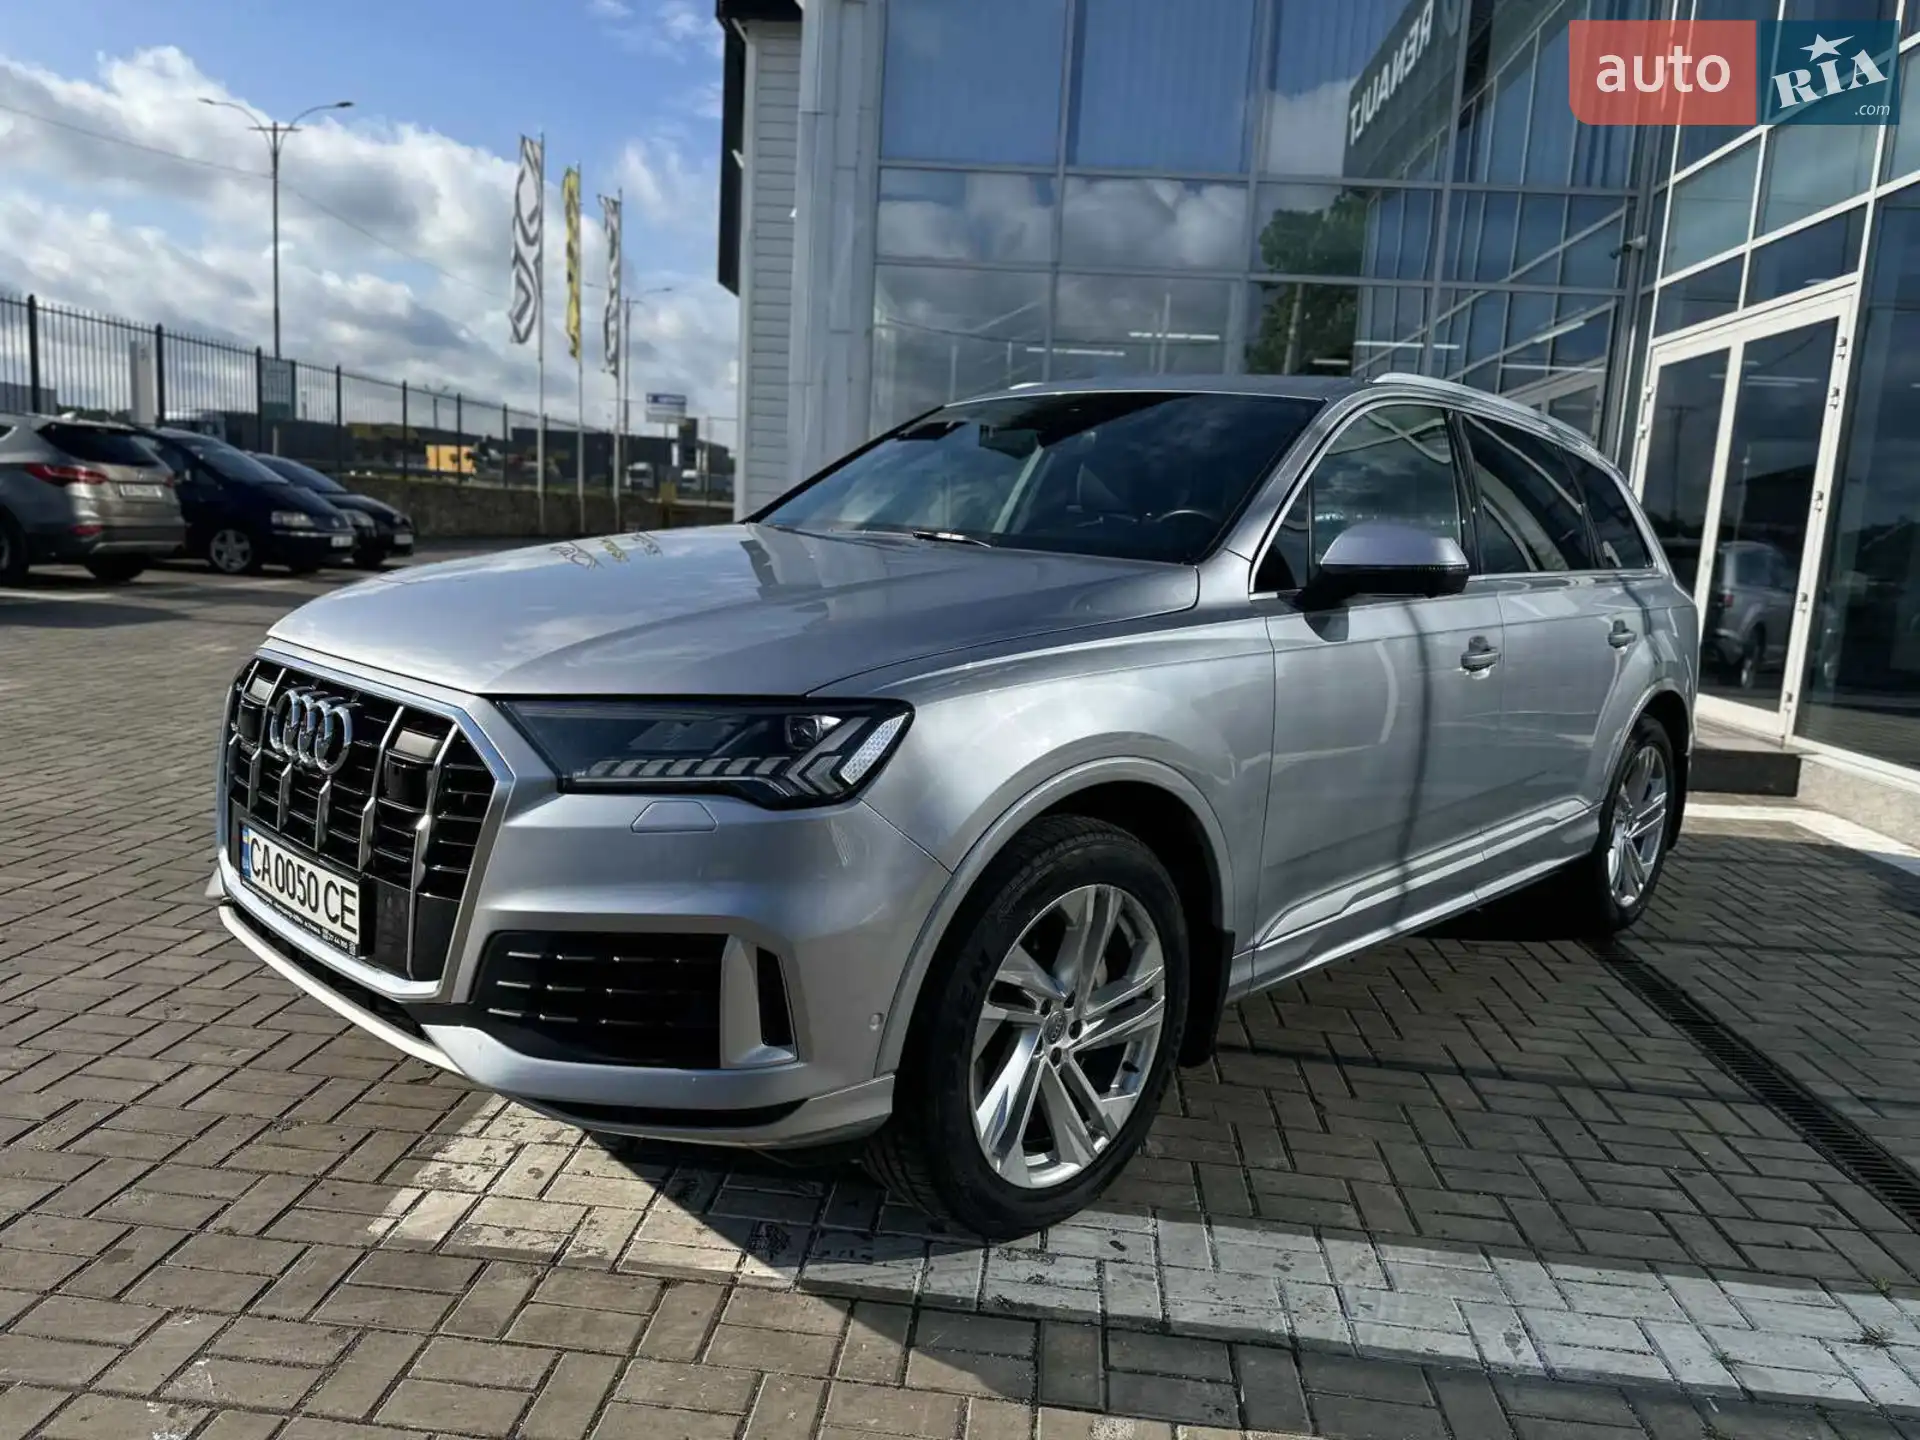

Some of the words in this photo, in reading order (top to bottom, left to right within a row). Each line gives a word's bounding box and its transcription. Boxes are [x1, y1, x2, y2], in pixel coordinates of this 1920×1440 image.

[251, 838, 272, 887] CA
[275, 853, 319, 913] 0050
[324, 881, 357, 935] CE
